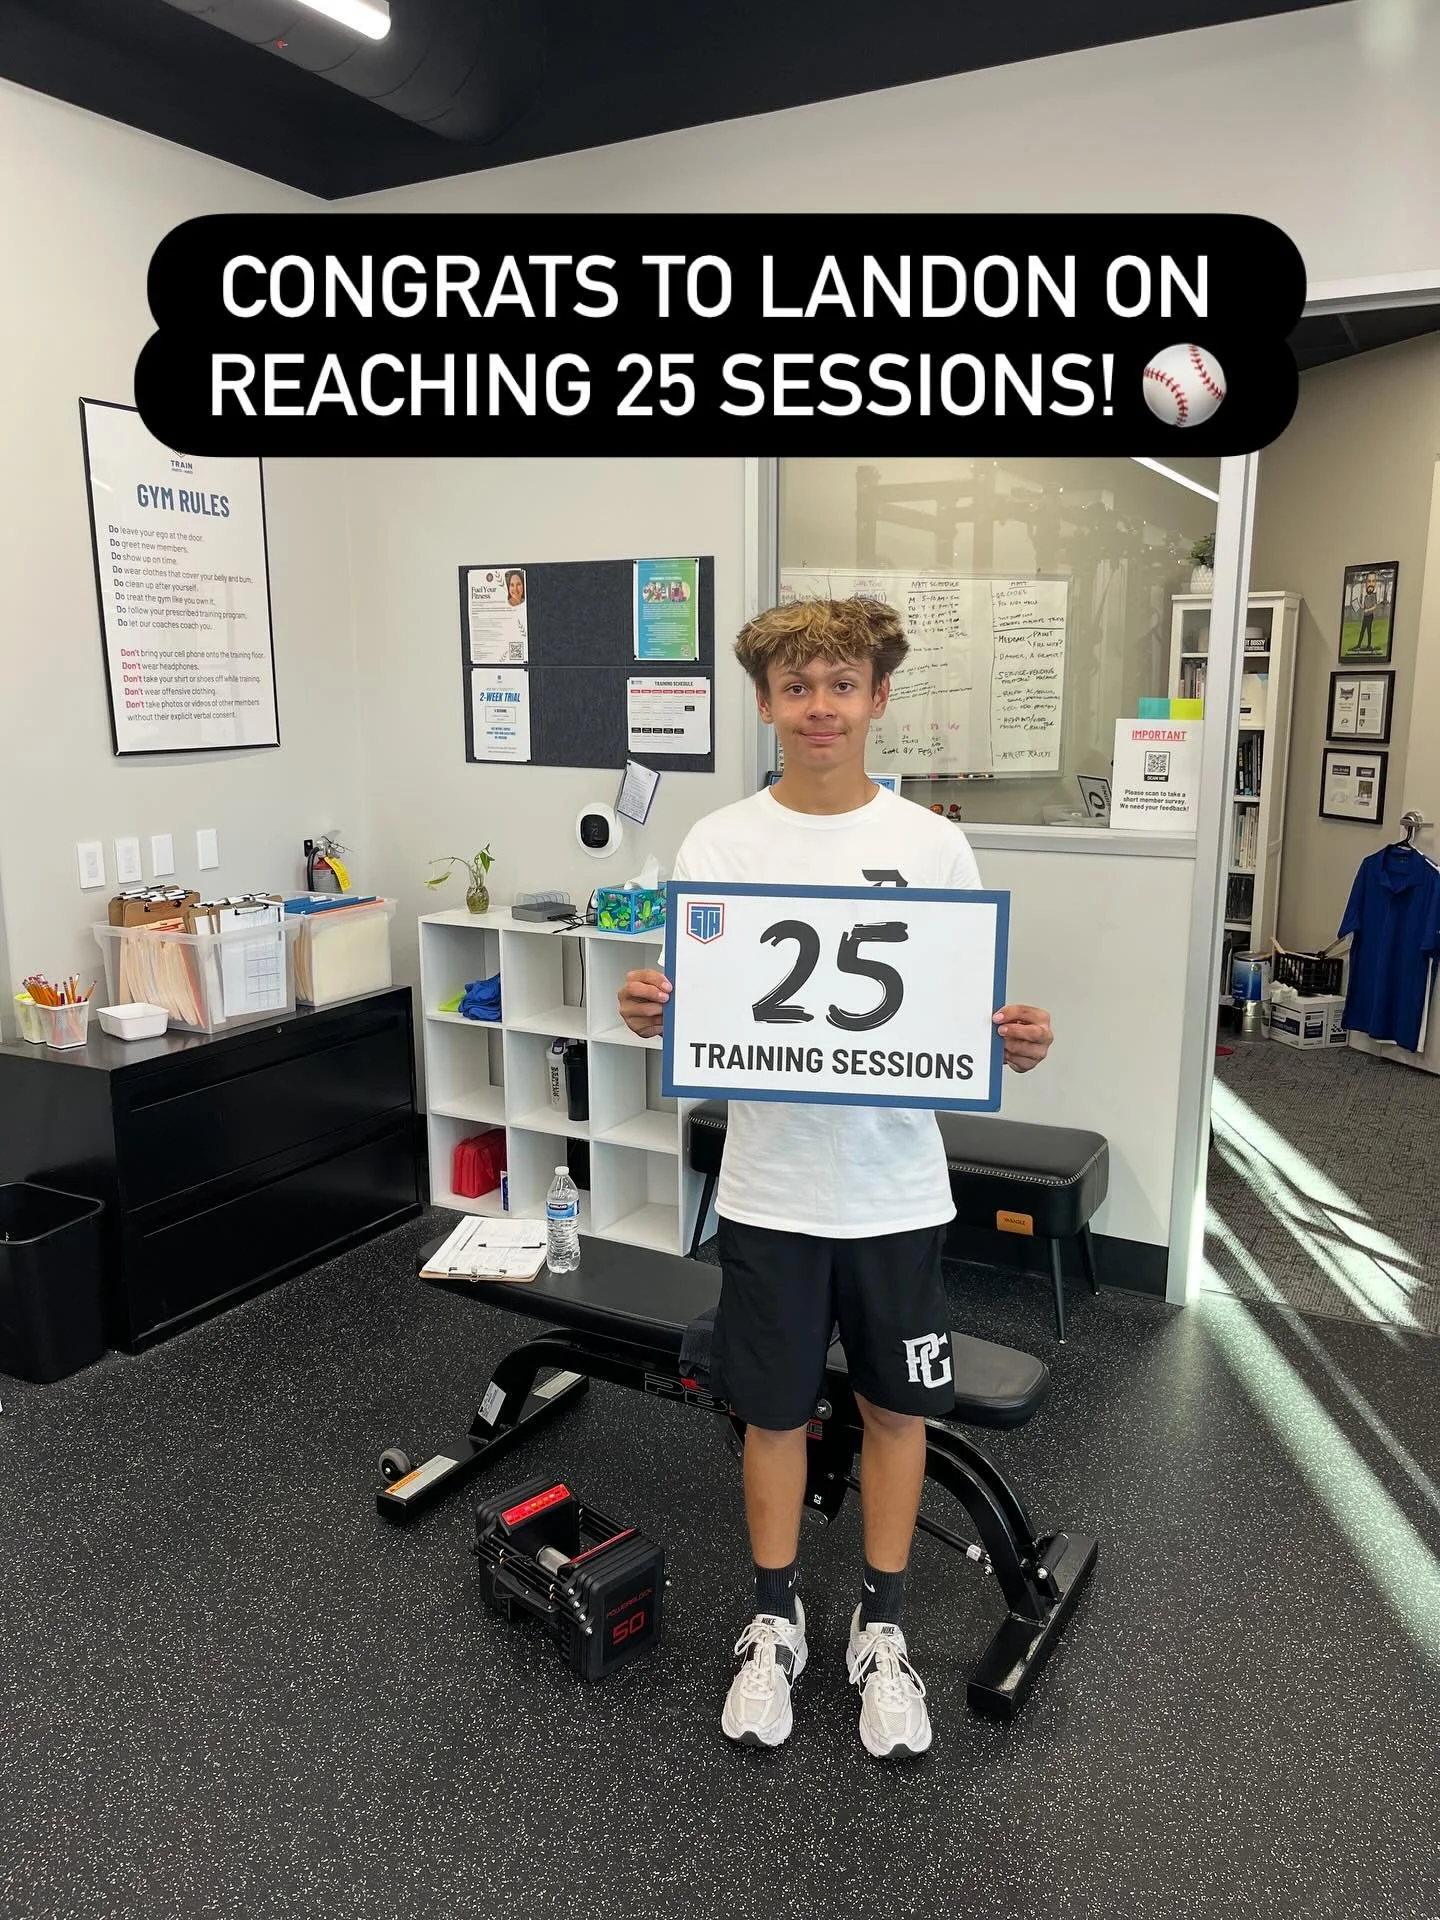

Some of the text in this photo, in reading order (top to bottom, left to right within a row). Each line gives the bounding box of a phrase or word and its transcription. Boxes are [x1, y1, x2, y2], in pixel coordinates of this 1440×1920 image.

[170, 460, 192, 469] TRAIN
[137, 484, 230, 518] GYM RULES
[108, 524, 119, 534] Do
[120, 526, 138, 536] leave
[140, 529, 154, 538] your
[156, 531, 168, 540] ego
[177, 532, 187, 540] the
[110, 538, 120, 547] Do
[122, 540, 140, 549] greet
[111, 552, 121, 560] Do
[123, 554, 141, 562] show
[112, 565, 122, 574] Do
[143, 568, 167, 577] clothes
[168, 570, 180, 578] that
[200, 574, 213, 582] your
[214, 574, 227, 583] belly
[114, 579, 124, 587] Do
[125, 580, 144, 588] clean
[155, 582, 171, 590] after
[127, 593, 144, 601] treat
[145, 594, 156, 602] the
[157, 596, 171, 604] gym
[172, 595, 183, 603] like
[184, 597, 195, 605] you
[116, 605, 126, 613] Do
[127, 606, 149, 614] follow
[150, 608, 164, 616] your
[166, 608, 198, 618] prescribed
[199, 610, 222, 620] training
[118, 618, 128, 627] Do
[129, 619, 138, 627] let
[152, 620, 179, 629] coaches
[121, 649, 140, 657] Don't
[141, 650, 158, 659] bring
[186, 651, 205, 659] phone
[230, 652, 251, 660] training
[215, 674, 224, 682] off
[480, 692, 520, 703] 2-WEEK TRIAL
[161, 700, 183, 708] photos
[171, 712, 193, 722] explicit
[1132, 730, 1188, 741] IMPORTANT
[752, 919, 909, 1032] 25
[690, 1042, 974, 1081] TRAINING SESSIONS
[761, 1617, 776, 1626] NIKE
[612, 1610, 645, 1645] 50
[881, 1626, 895, 1634] NIKE
